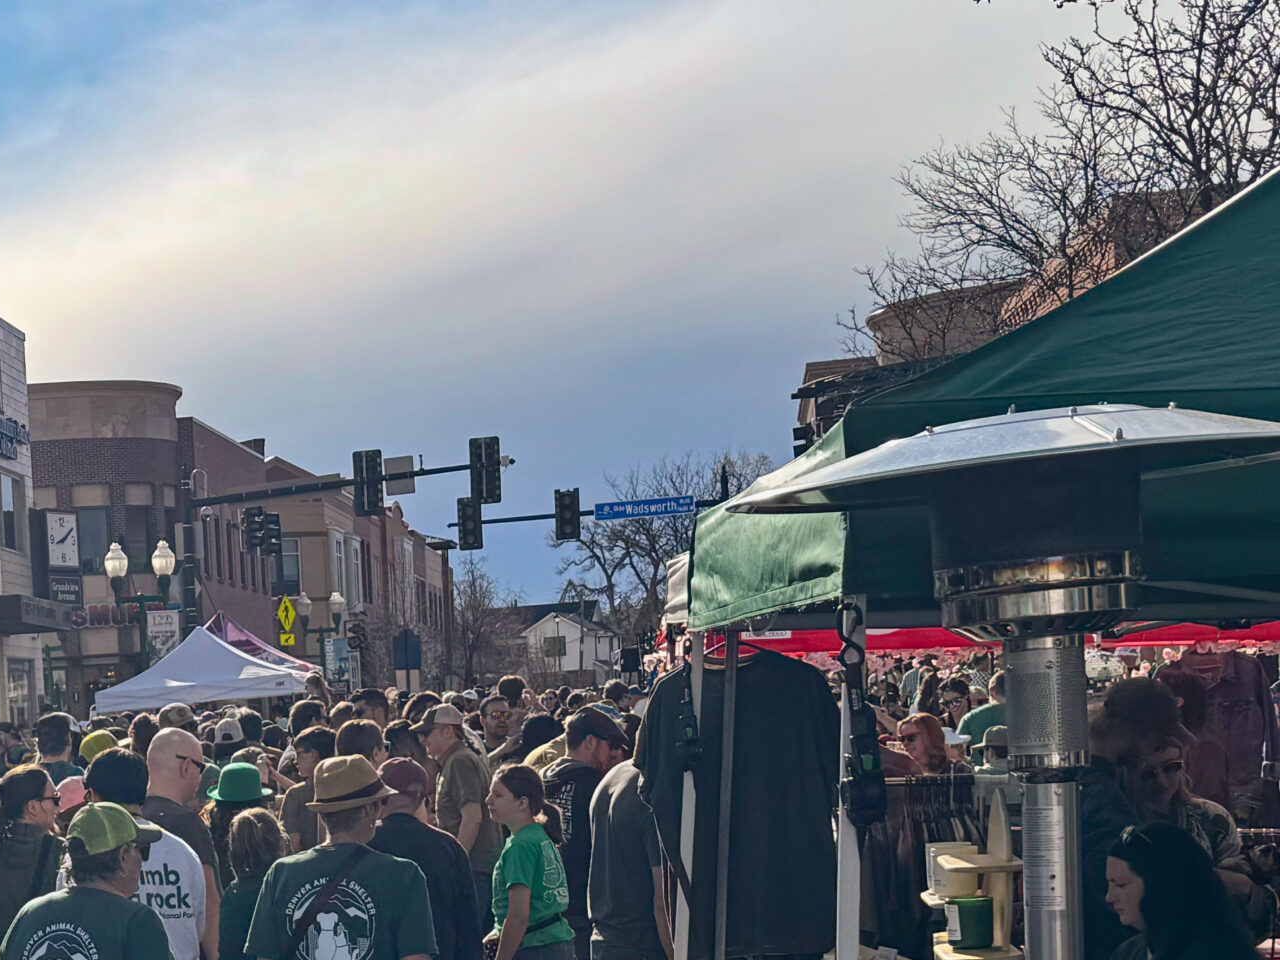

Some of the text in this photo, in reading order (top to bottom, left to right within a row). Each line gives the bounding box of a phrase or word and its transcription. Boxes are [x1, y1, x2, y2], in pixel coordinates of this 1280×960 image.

[625, 501, 677, 515] Wadsworth
[50, 534, 55, 544] 9
[71, 536, 76, 546] 3
[61, 553, 66, 563] 6
[140, 863, 180, 885] imb
[146, 886, 191, 909] rock
[285, 877, 376, 915] DENVER ANL SHELTER
[45, 922, 75, 934] ANIMAL
[76, 927, 99, 960] SHELTER
